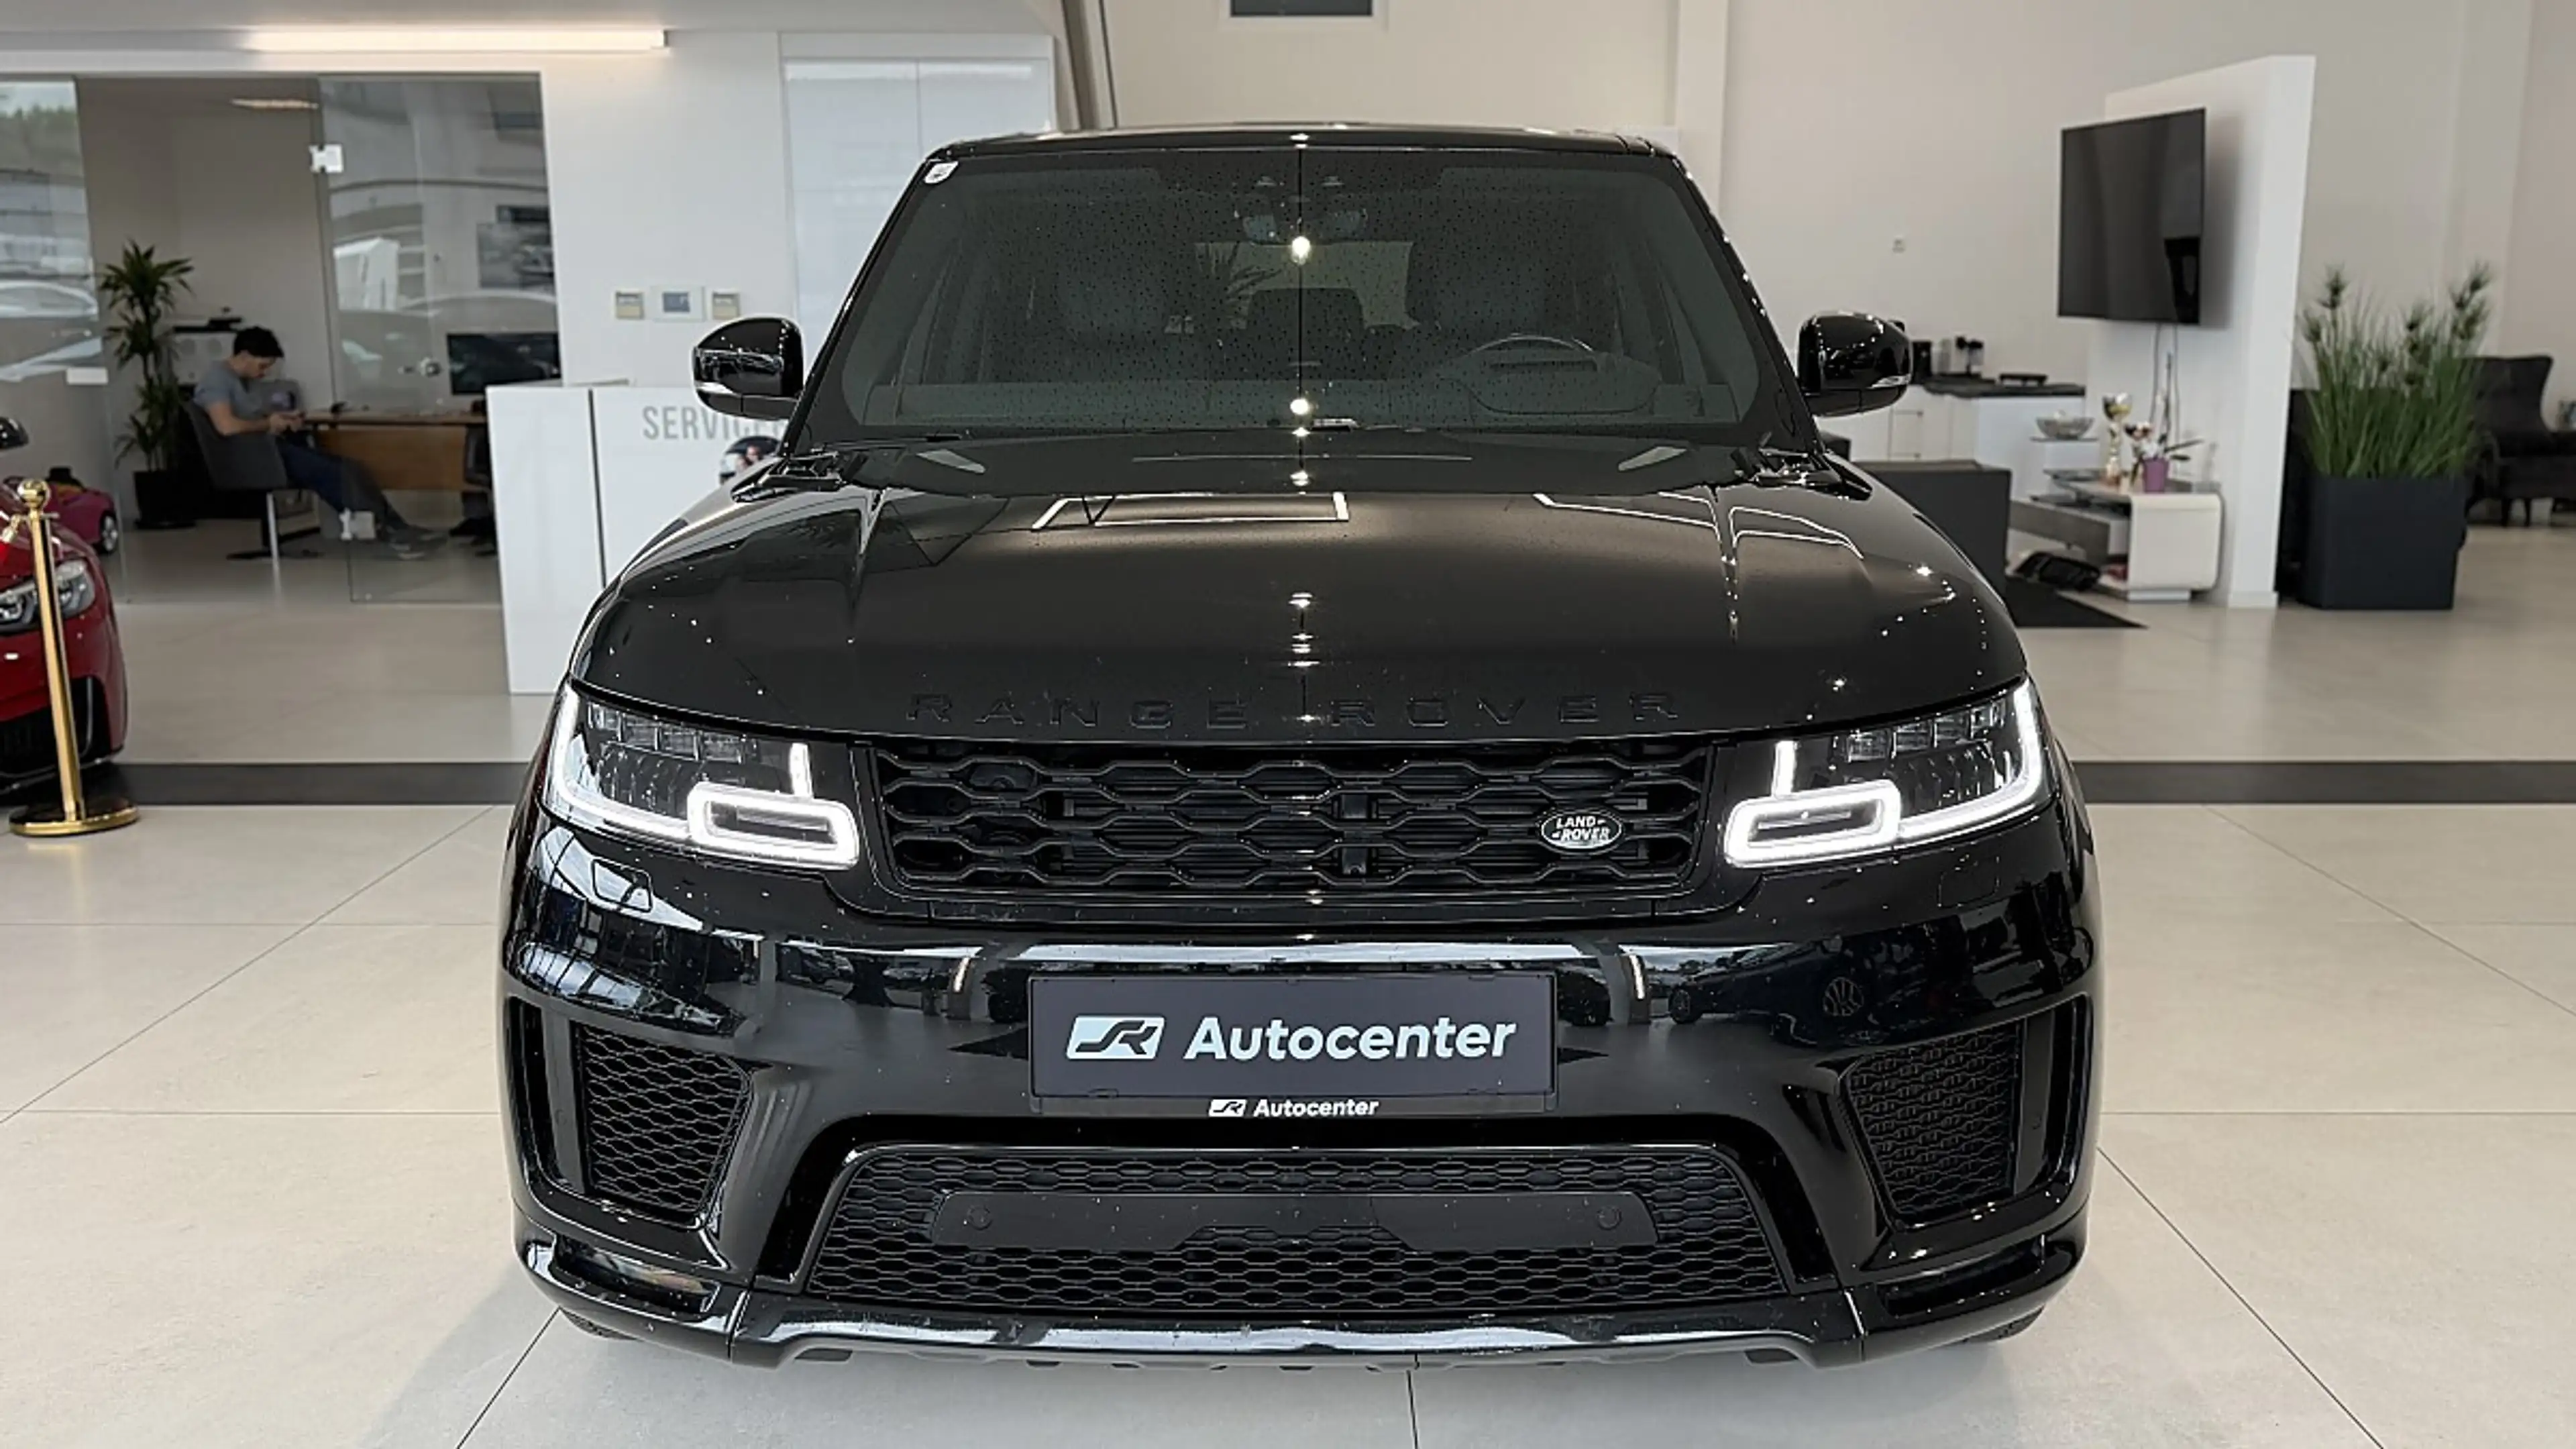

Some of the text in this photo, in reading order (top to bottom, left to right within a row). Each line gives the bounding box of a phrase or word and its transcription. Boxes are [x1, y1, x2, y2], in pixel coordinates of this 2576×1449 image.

[908, 692, 1678, 729] RANGE ROVER
[1183, 1016, 1517, 1060] Autocenter
[1253, 1098, 1379, 1118] Autocenter
